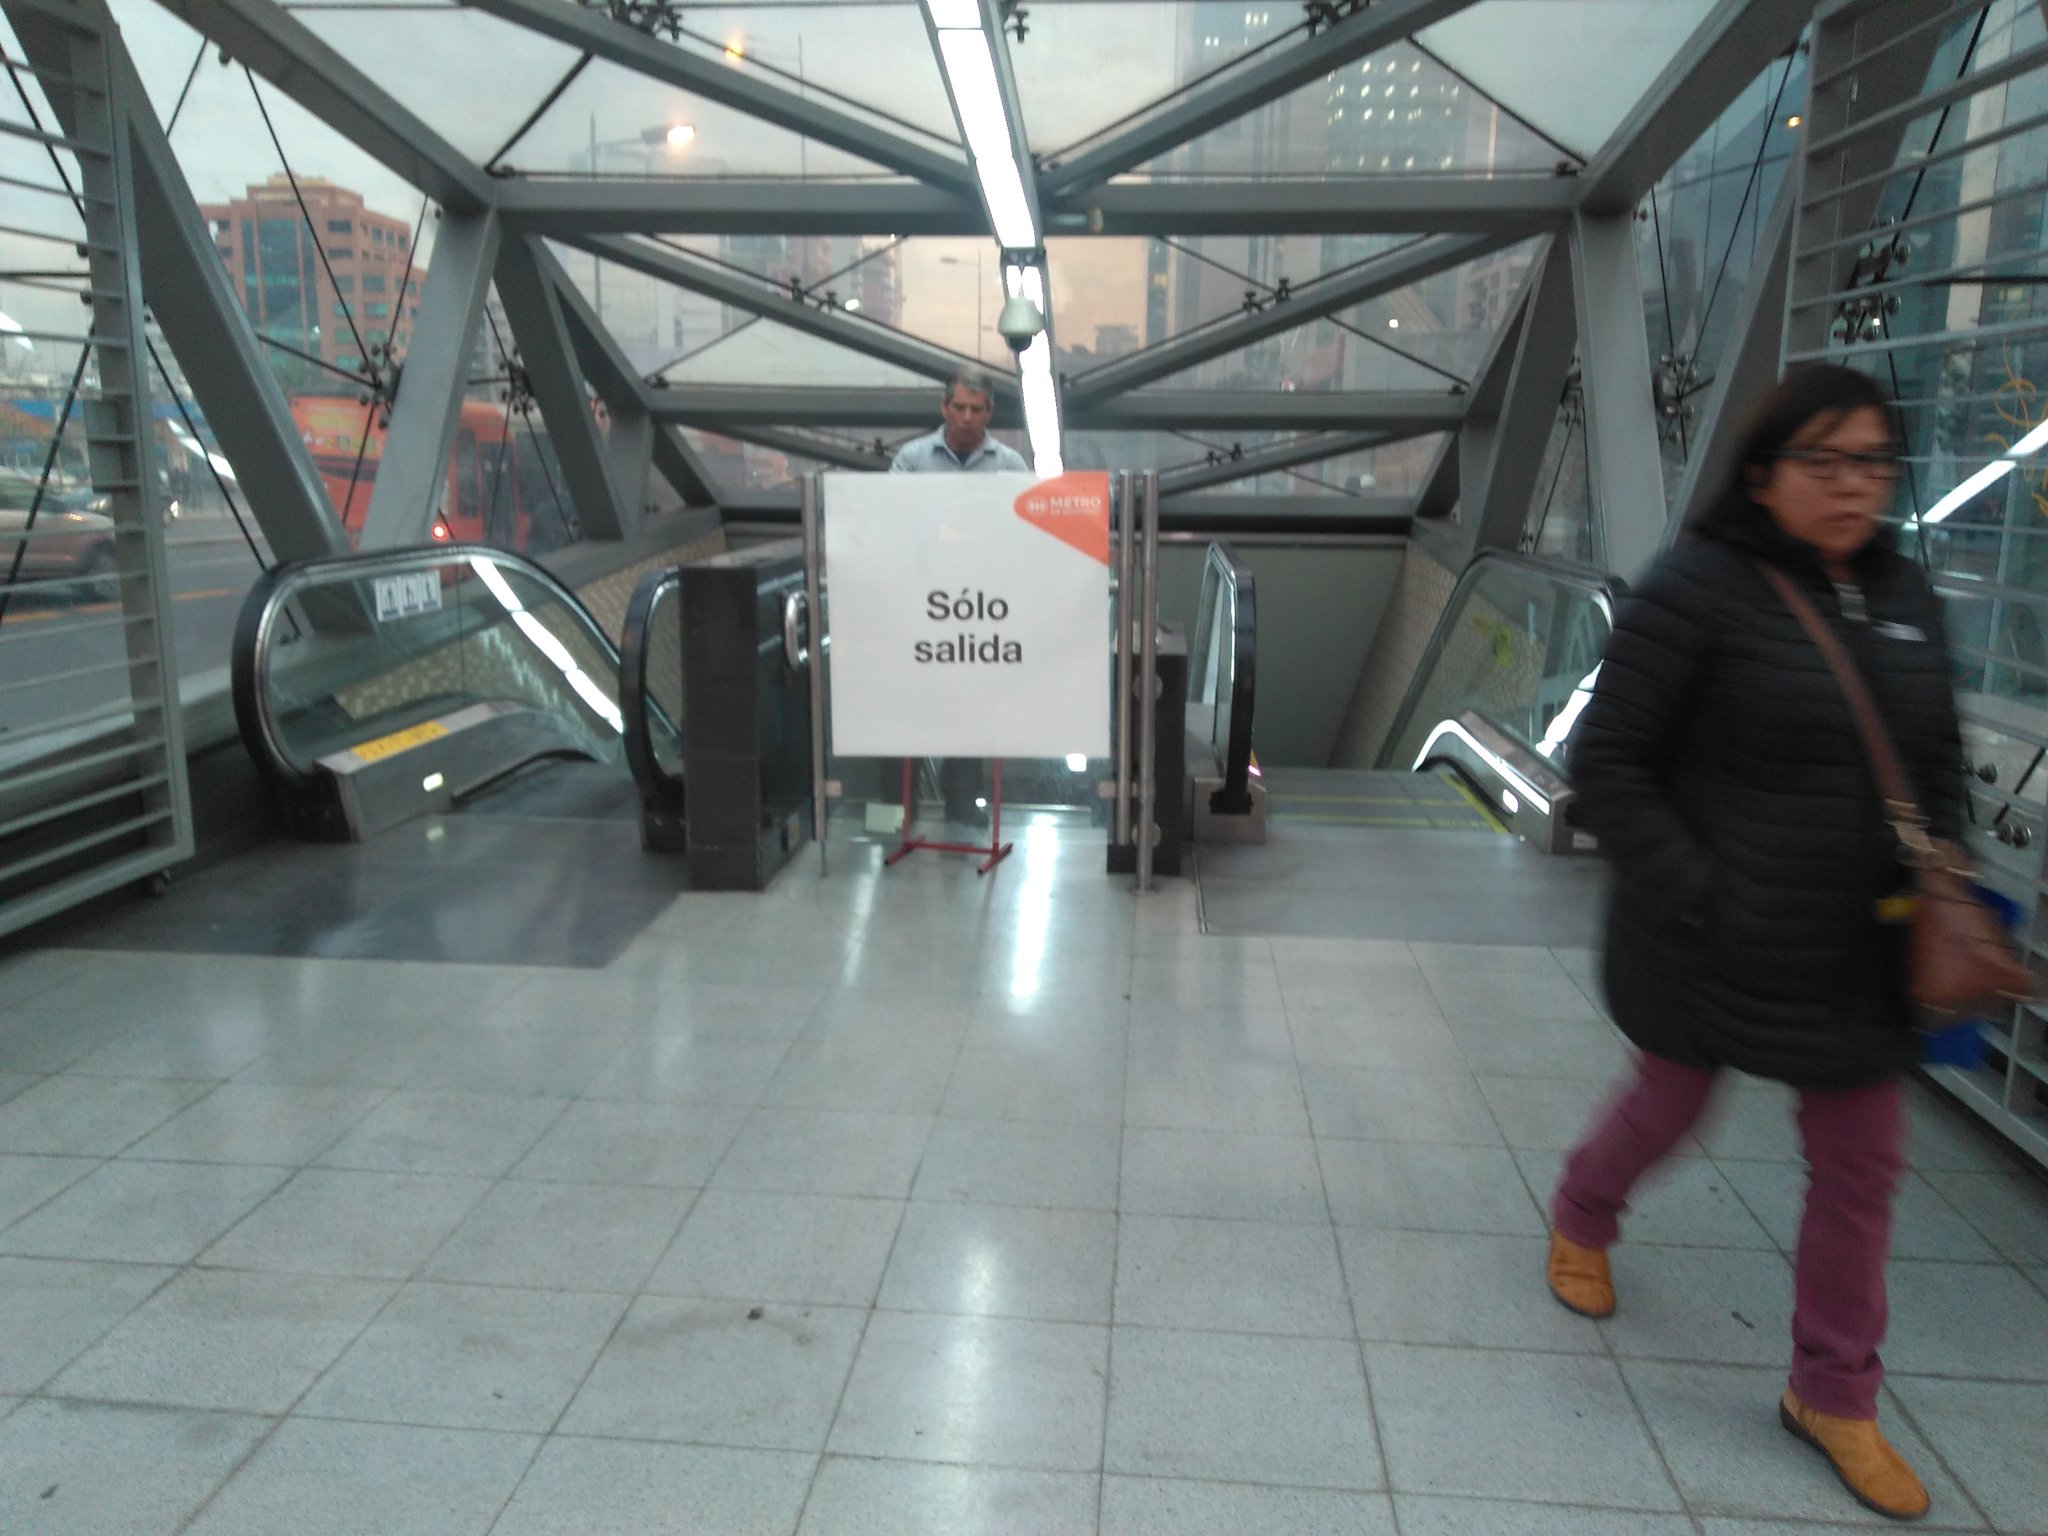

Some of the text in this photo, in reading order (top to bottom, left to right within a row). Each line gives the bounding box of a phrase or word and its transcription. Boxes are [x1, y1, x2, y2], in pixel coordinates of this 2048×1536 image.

[1049, 495, 1102, 508] METRO
[927, 587, 1009, 621] Sólo
[914, 634, 1023, 664] salida
